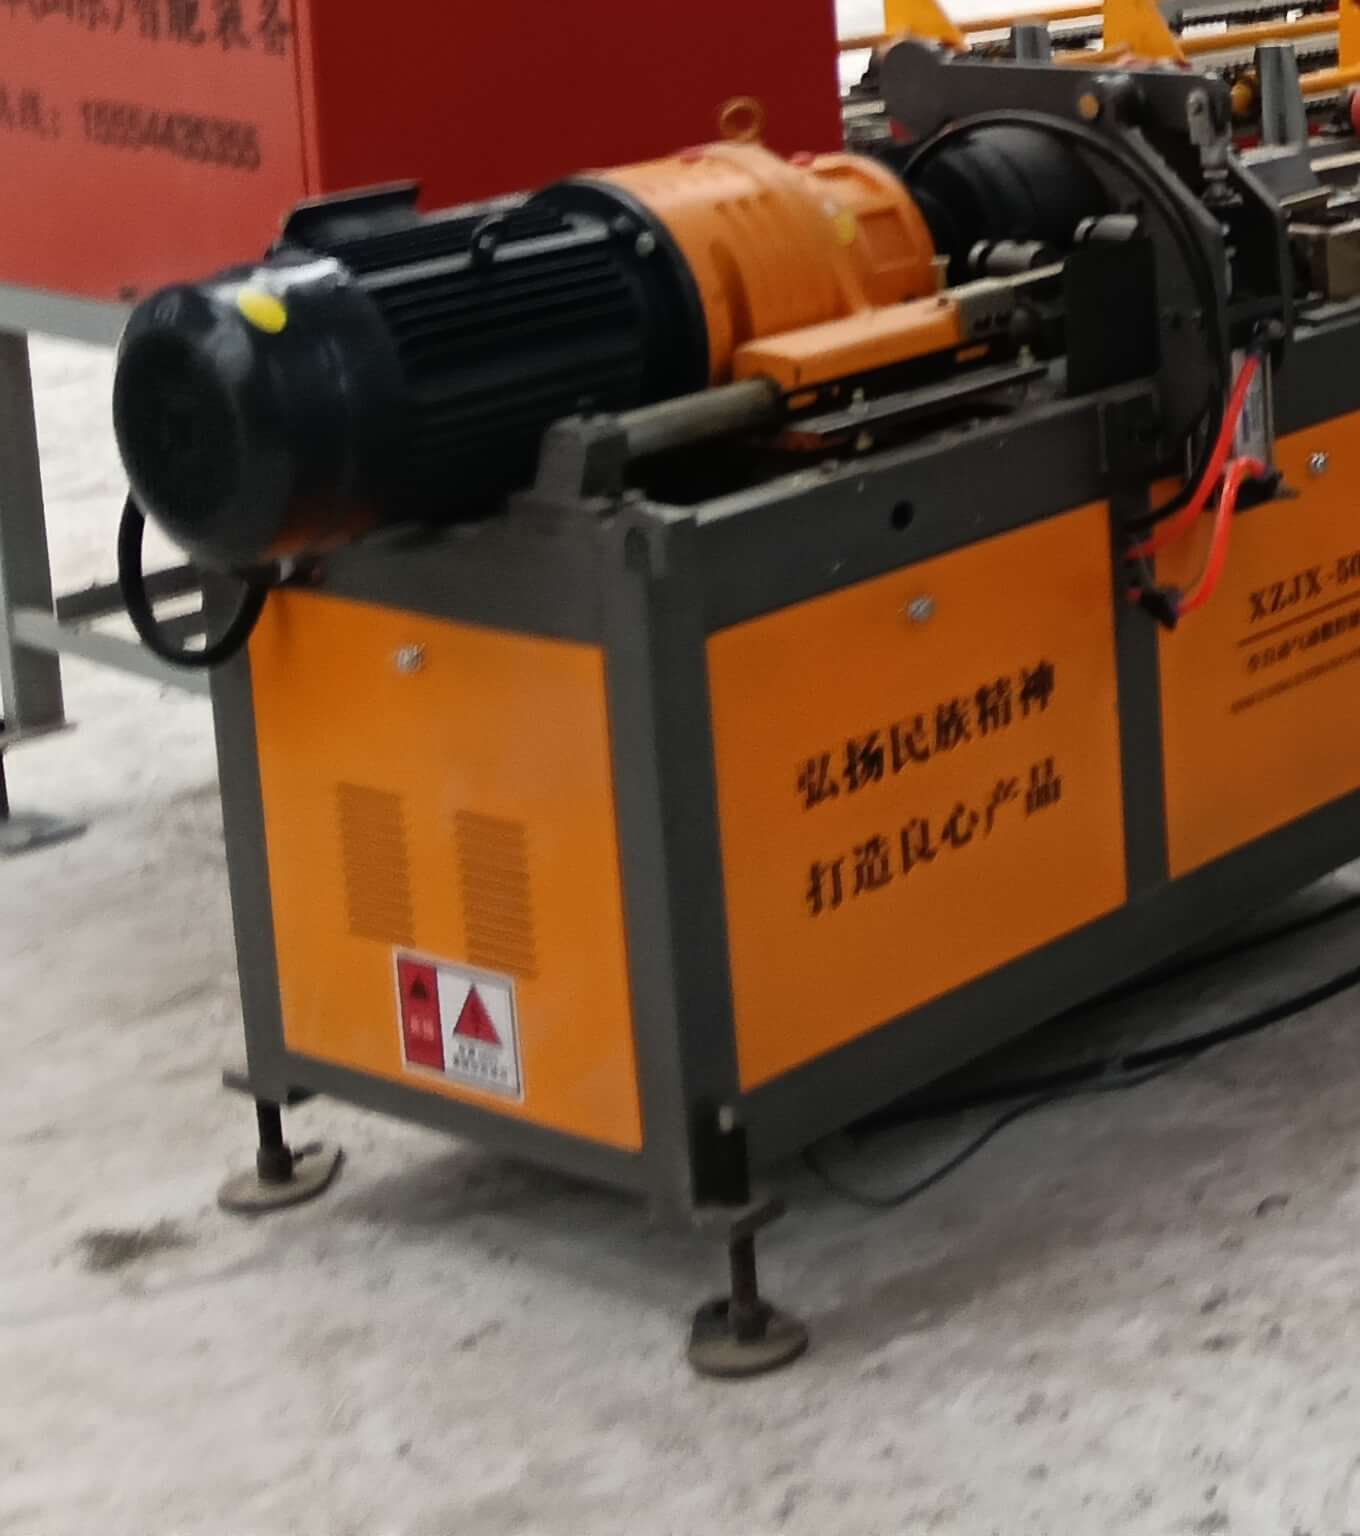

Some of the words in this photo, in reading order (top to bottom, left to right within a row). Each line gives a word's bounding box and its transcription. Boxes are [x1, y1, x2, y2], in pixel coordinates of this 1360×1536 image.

[795, 658, 1055, 811] 弘扬民族精神
[805, 756, 1063, 918] 打造良心产品
